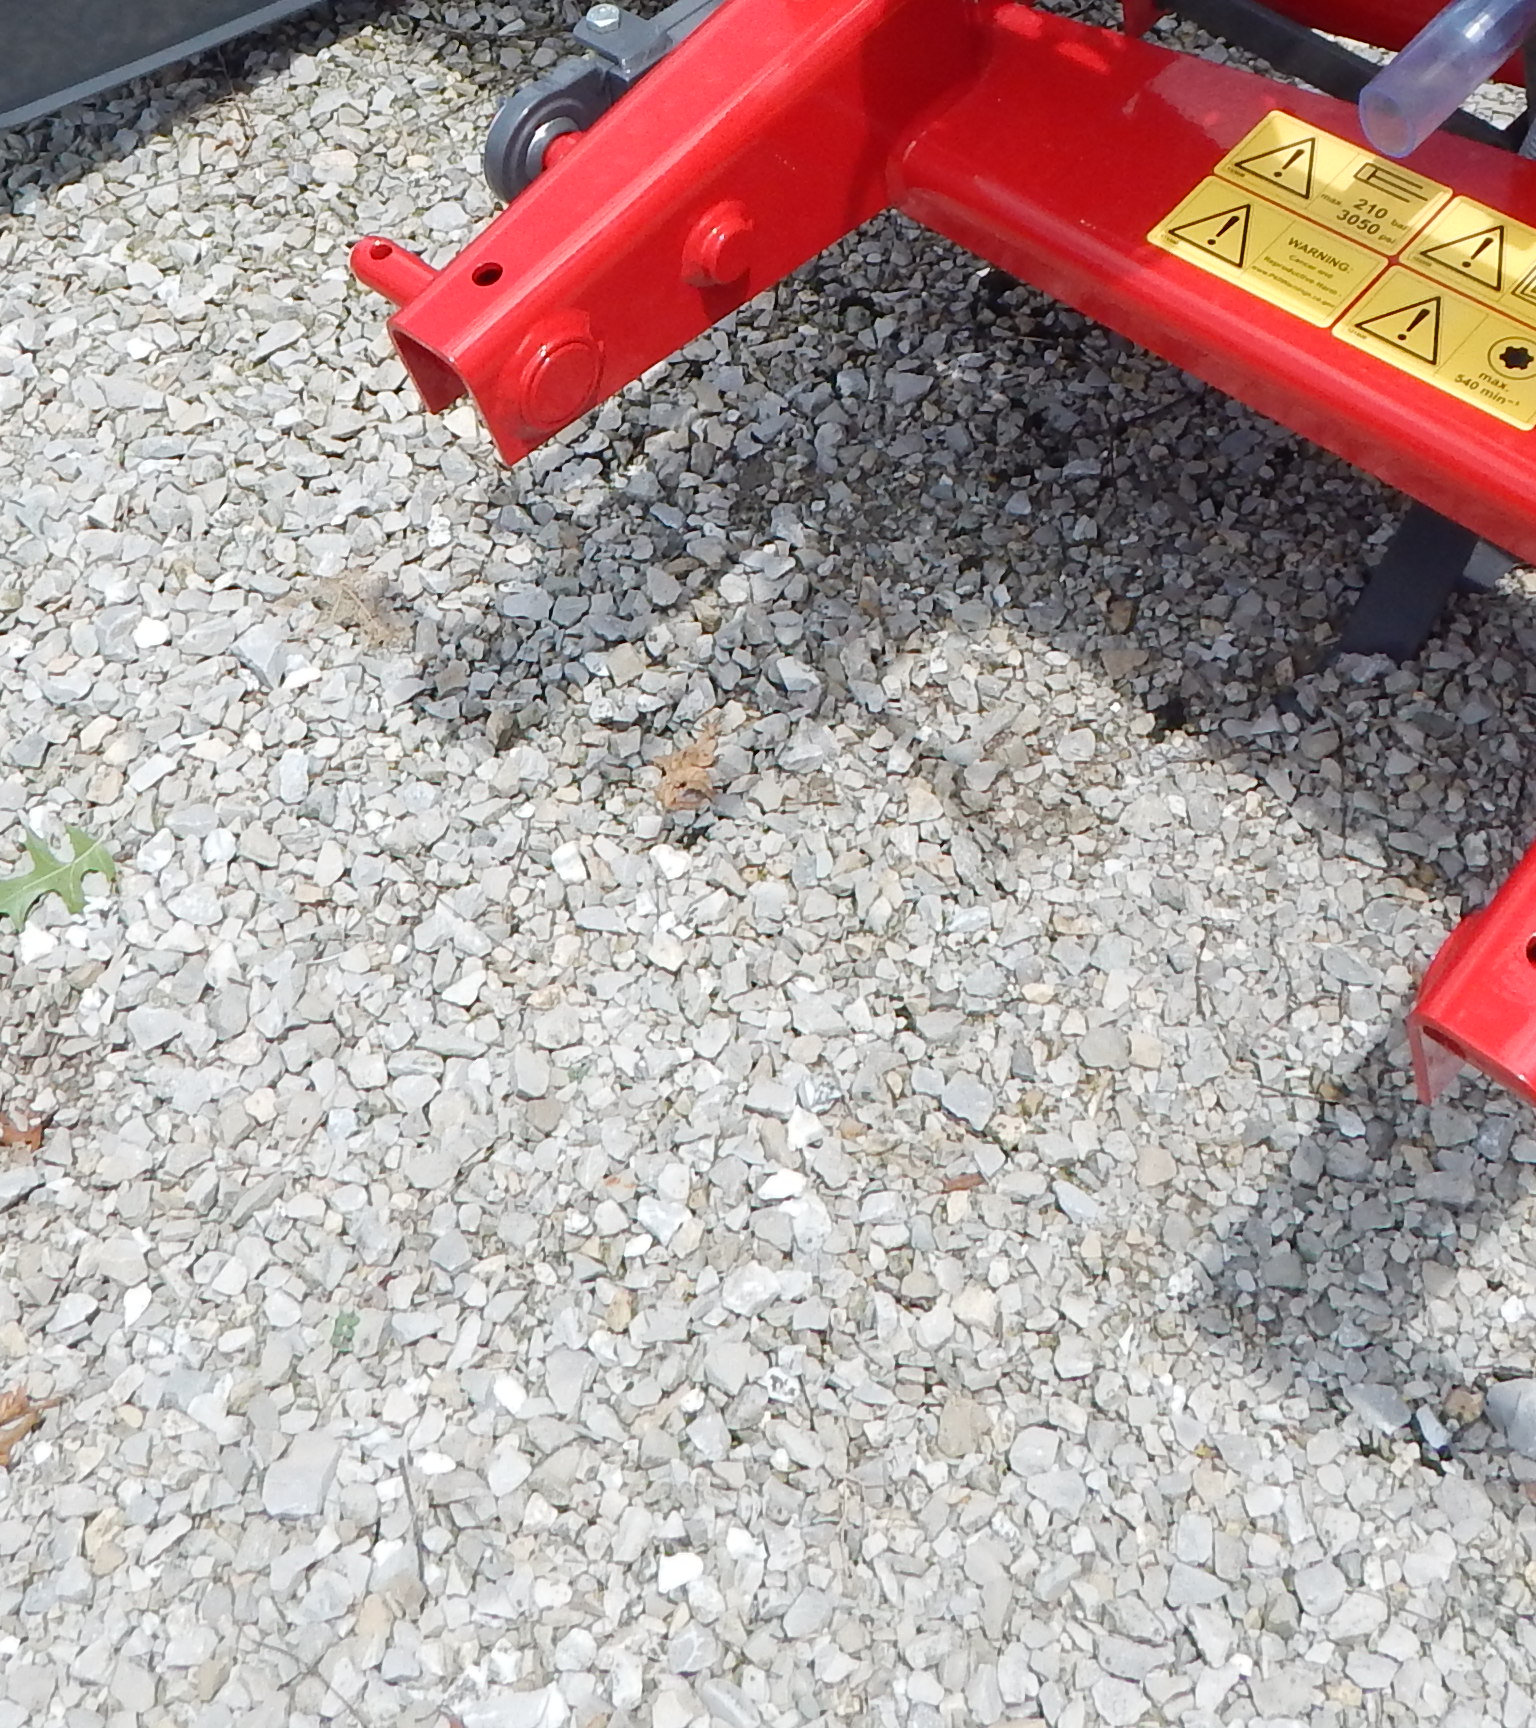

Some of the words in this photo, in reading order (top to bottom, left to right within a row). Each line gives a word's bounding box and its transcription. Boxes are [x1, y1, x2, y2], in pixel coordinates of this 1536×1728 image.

[1336, 209, 1381, 235] 3050
[1378, 234, 1396, 245] psi
[1353, 198, 1389, 219] 210
[1390, 218, 1408, 231] bar
[1454, 374, 1480, 390] 540
[1478, 372, 1510, 393] max.
